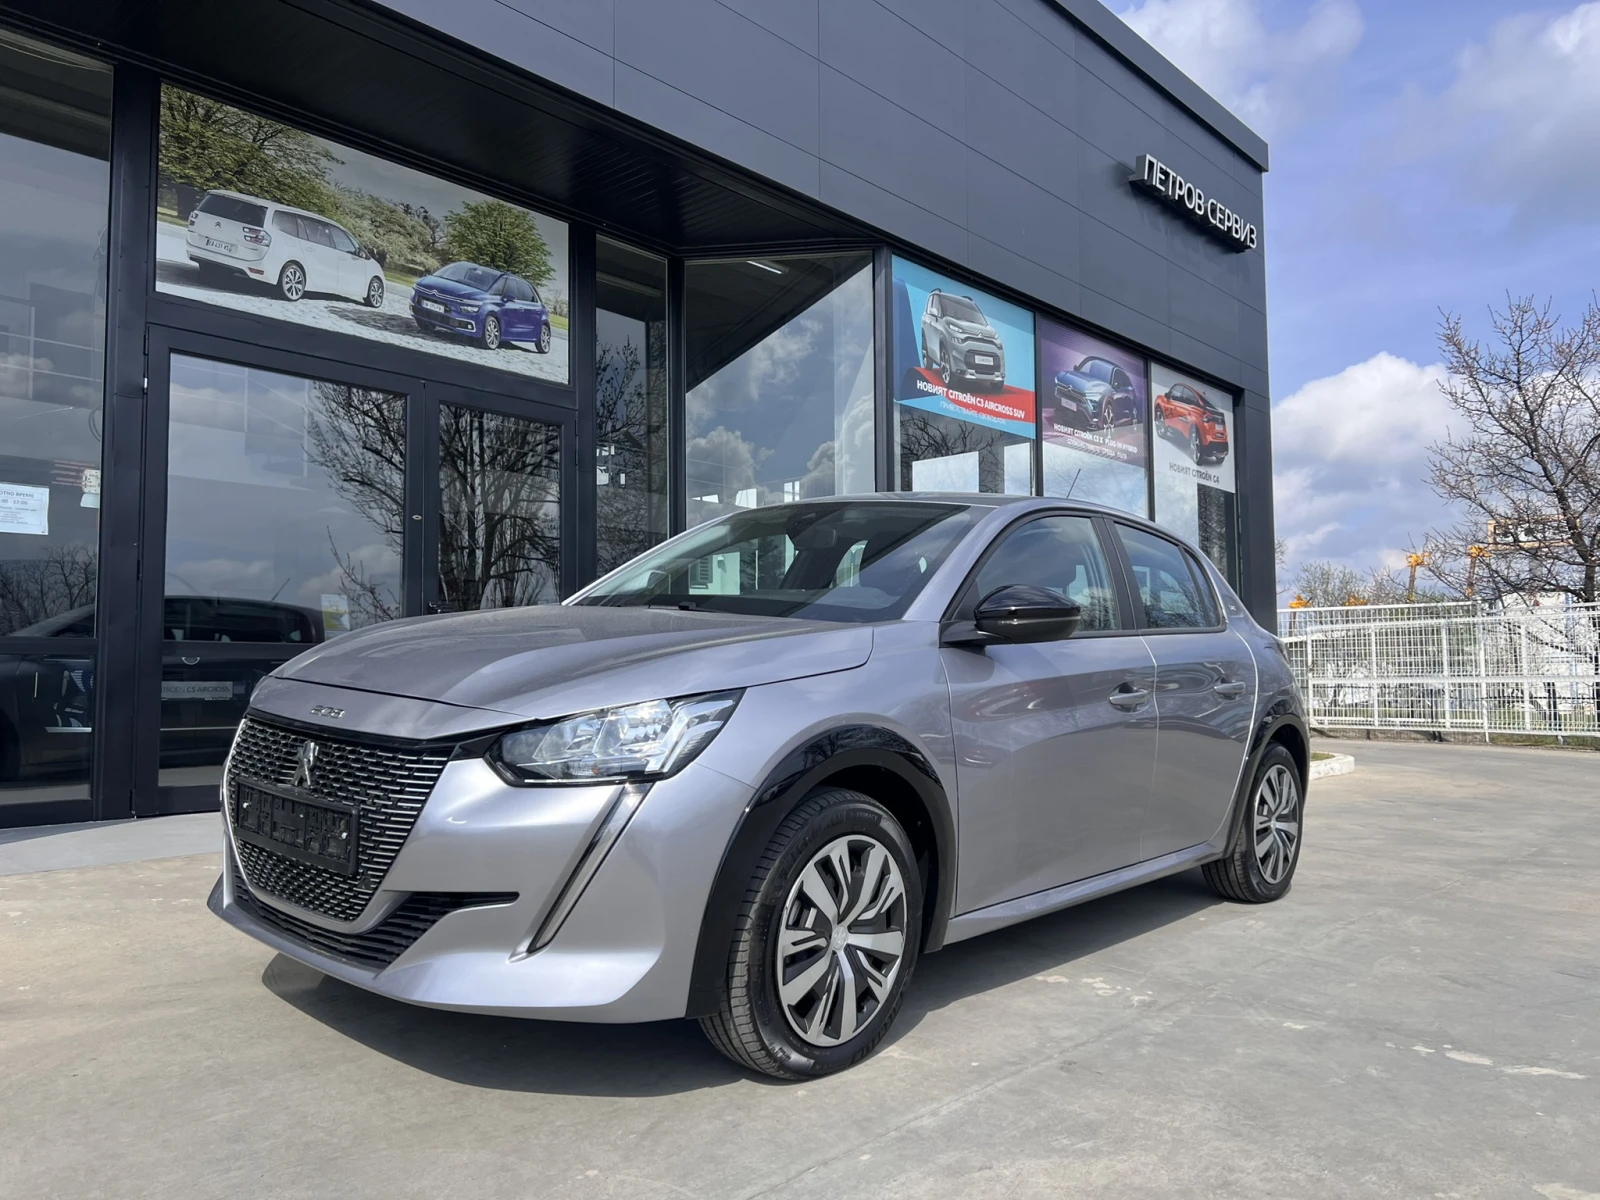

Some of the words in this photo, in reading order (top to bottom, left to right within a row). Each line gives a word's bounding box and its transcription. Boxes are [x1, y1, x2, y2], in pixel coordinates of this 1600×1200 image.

[1144, 153, 1205, 216] ПЕТРОВ
[1207, 198, 1257, 249] СЕРВИЗ
[916, 379, 948, 397] НОВИЯТ
[948, 389, 976, 406] CITROËN
[976, 398, 984, 408] C3
[984, 401, 1013, 416] AIRCROSS
[1013, 408, 1025, 419] SUV
[1053, 423, 1074, 436] НОВИЯТ
[1074, 429, 1093, 441] CITROËN
[1168, 462, 1191, 475] НОВИЯТ
[1191, 468, 1212, 481] CITROËN
[1212, 475, 1220, 484] C4
[310, 704, 345, 719] 208
